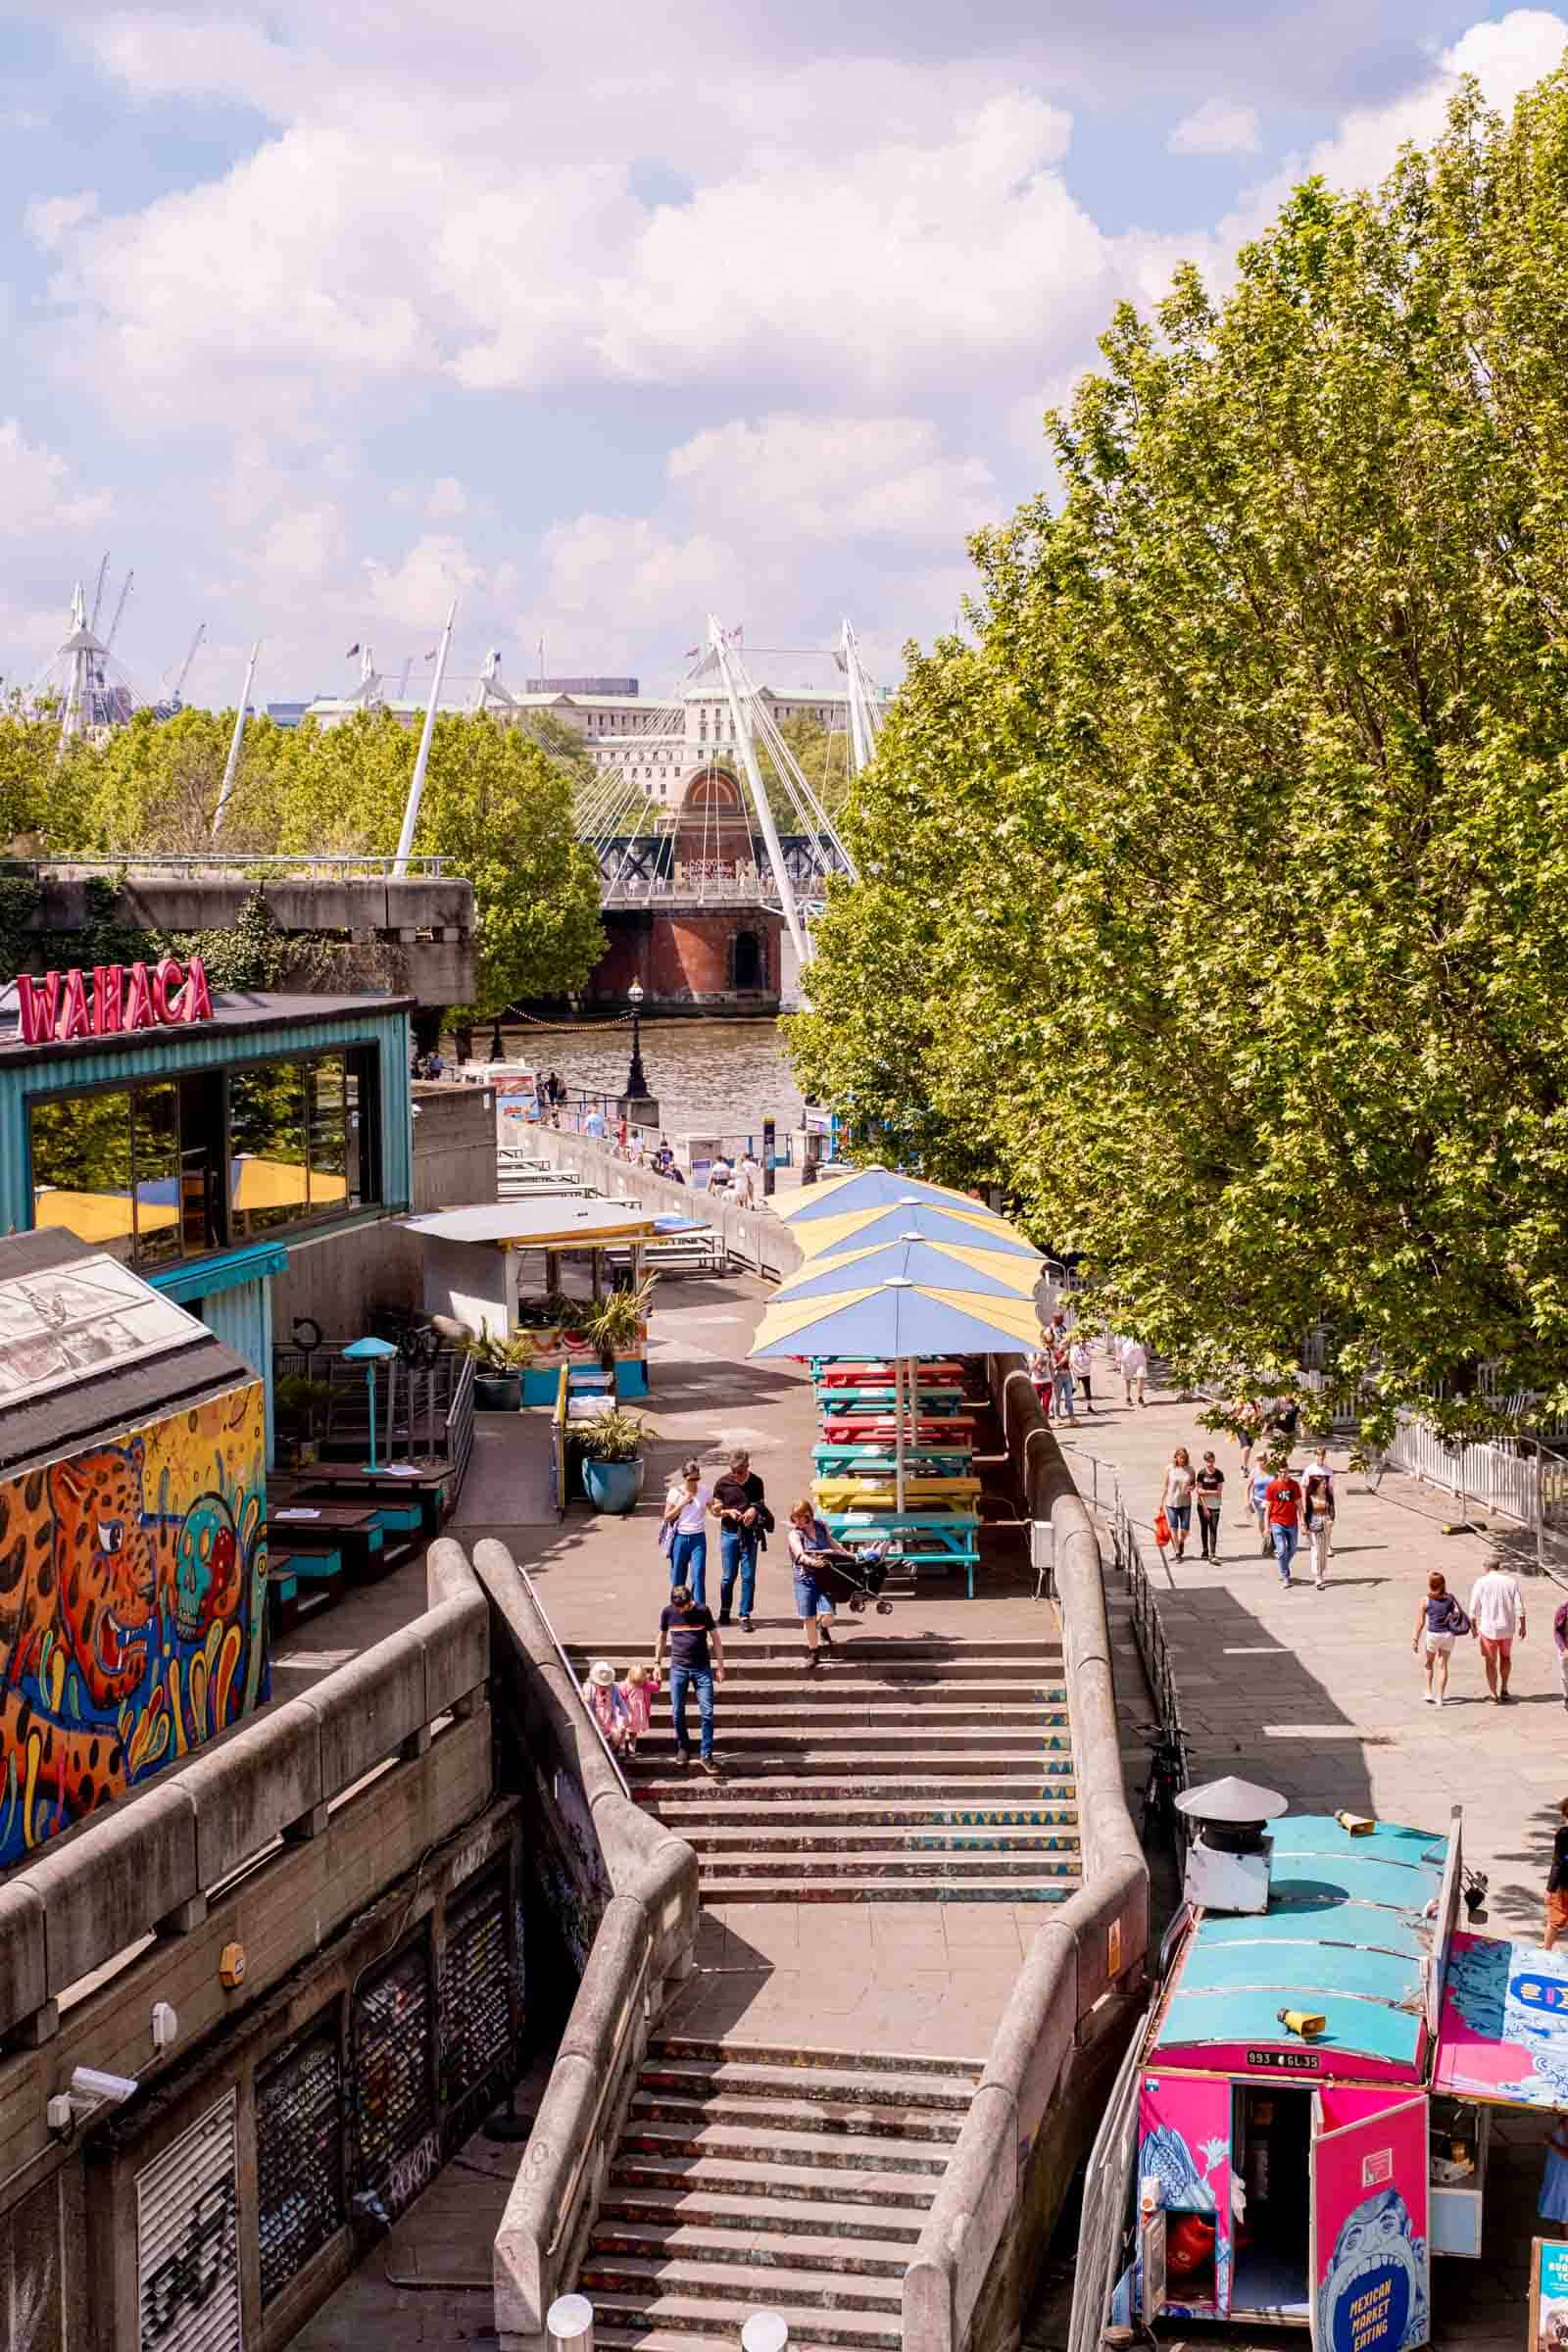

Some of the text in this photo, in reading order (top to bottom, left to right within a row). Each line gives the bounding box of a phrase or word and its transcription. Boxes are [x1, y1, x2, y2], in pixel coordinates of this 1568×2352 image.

[17, 956, 214, 1045] WAHACA
[1349, 2278, 1392, 2319] MEXICAN
[1351, 2298, 1391, 2336] MARKET
[1354, 2319, 1388, 2352] EATING
